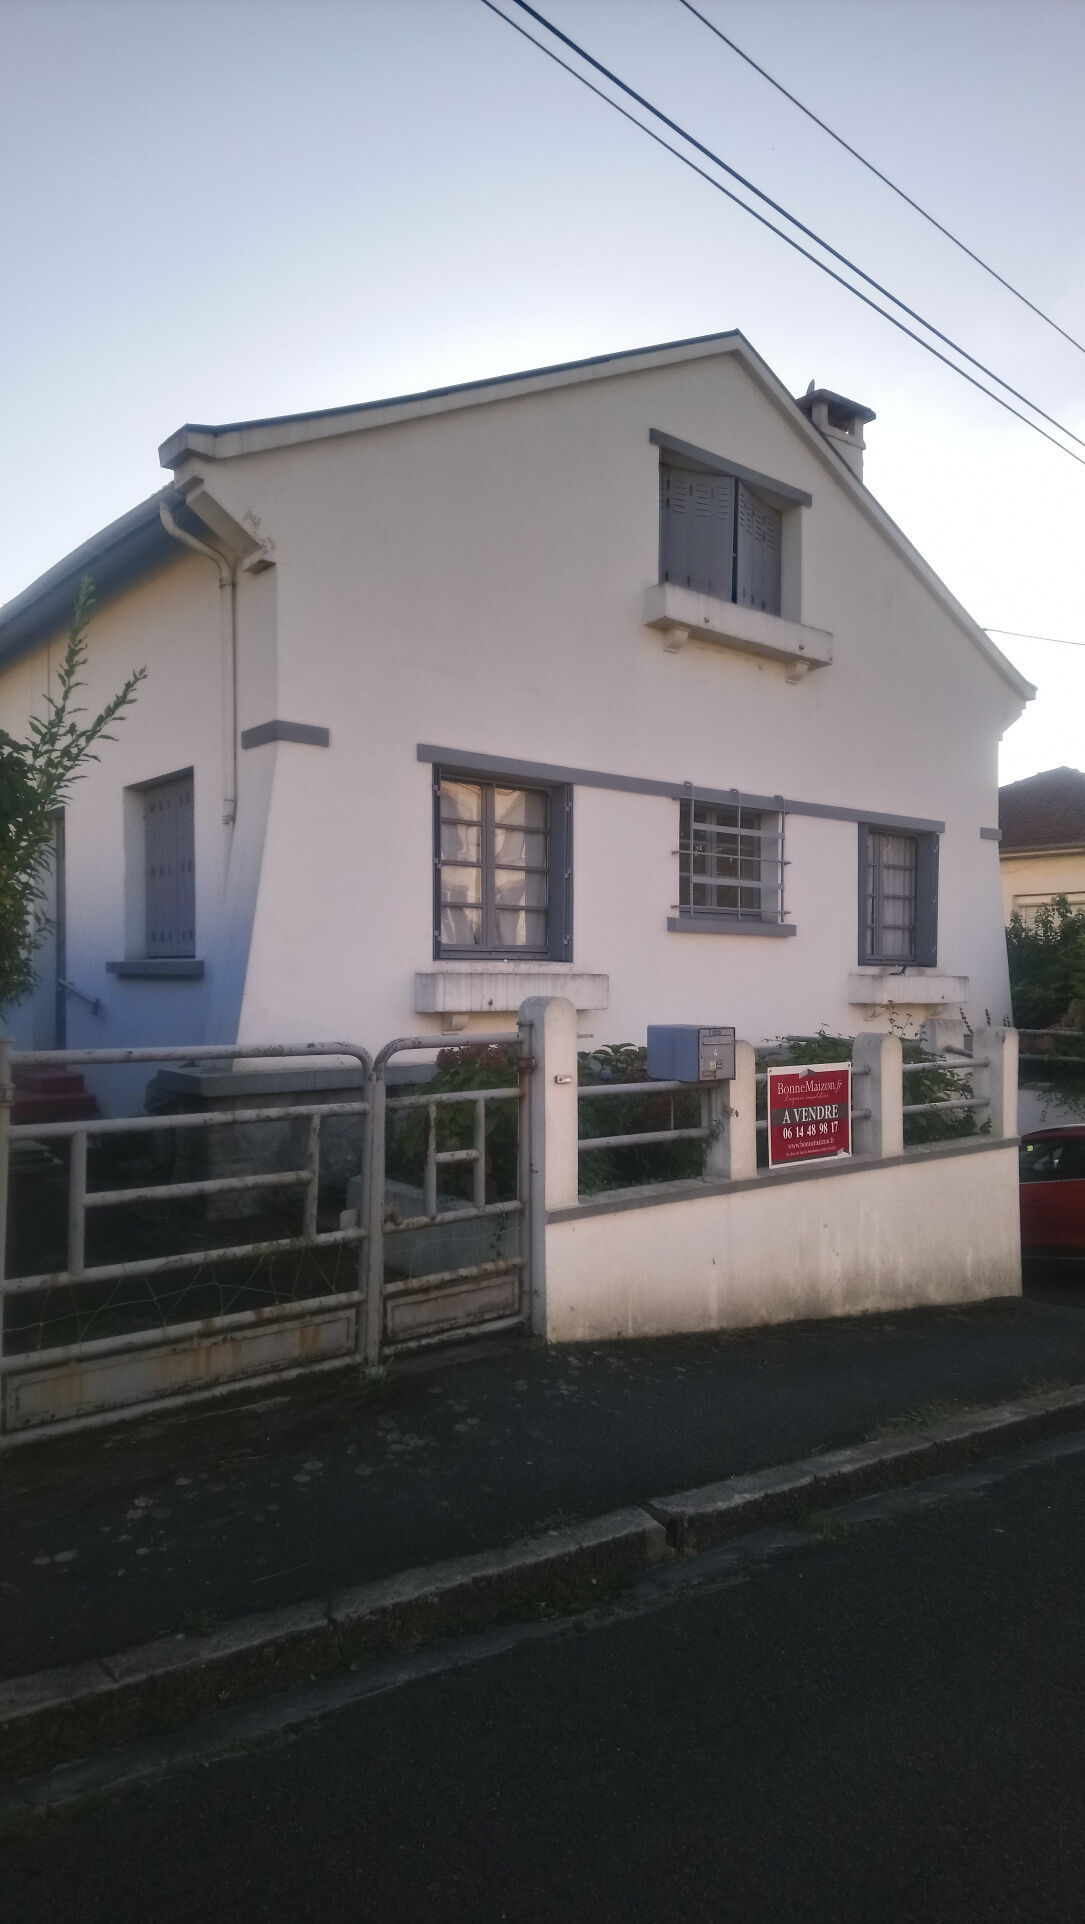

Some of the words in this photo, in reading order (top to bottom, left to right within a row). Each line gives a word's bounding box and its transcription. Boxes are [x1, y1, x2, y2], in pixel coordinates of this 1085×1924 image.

[777, 1079, 843, 1095] BonneMaizon.fr
[783, 1109, 791, 1124] A
[794, 1104, 839, 1123] VENDRE
[783, 1127, 792, 1139] 06
[796, 1125, 804, 1138] 14
[807, 1123, 816, 1136] 48
[819, 1122, 828, 1135] 98
[831, 1121, 839, 1133] 17
